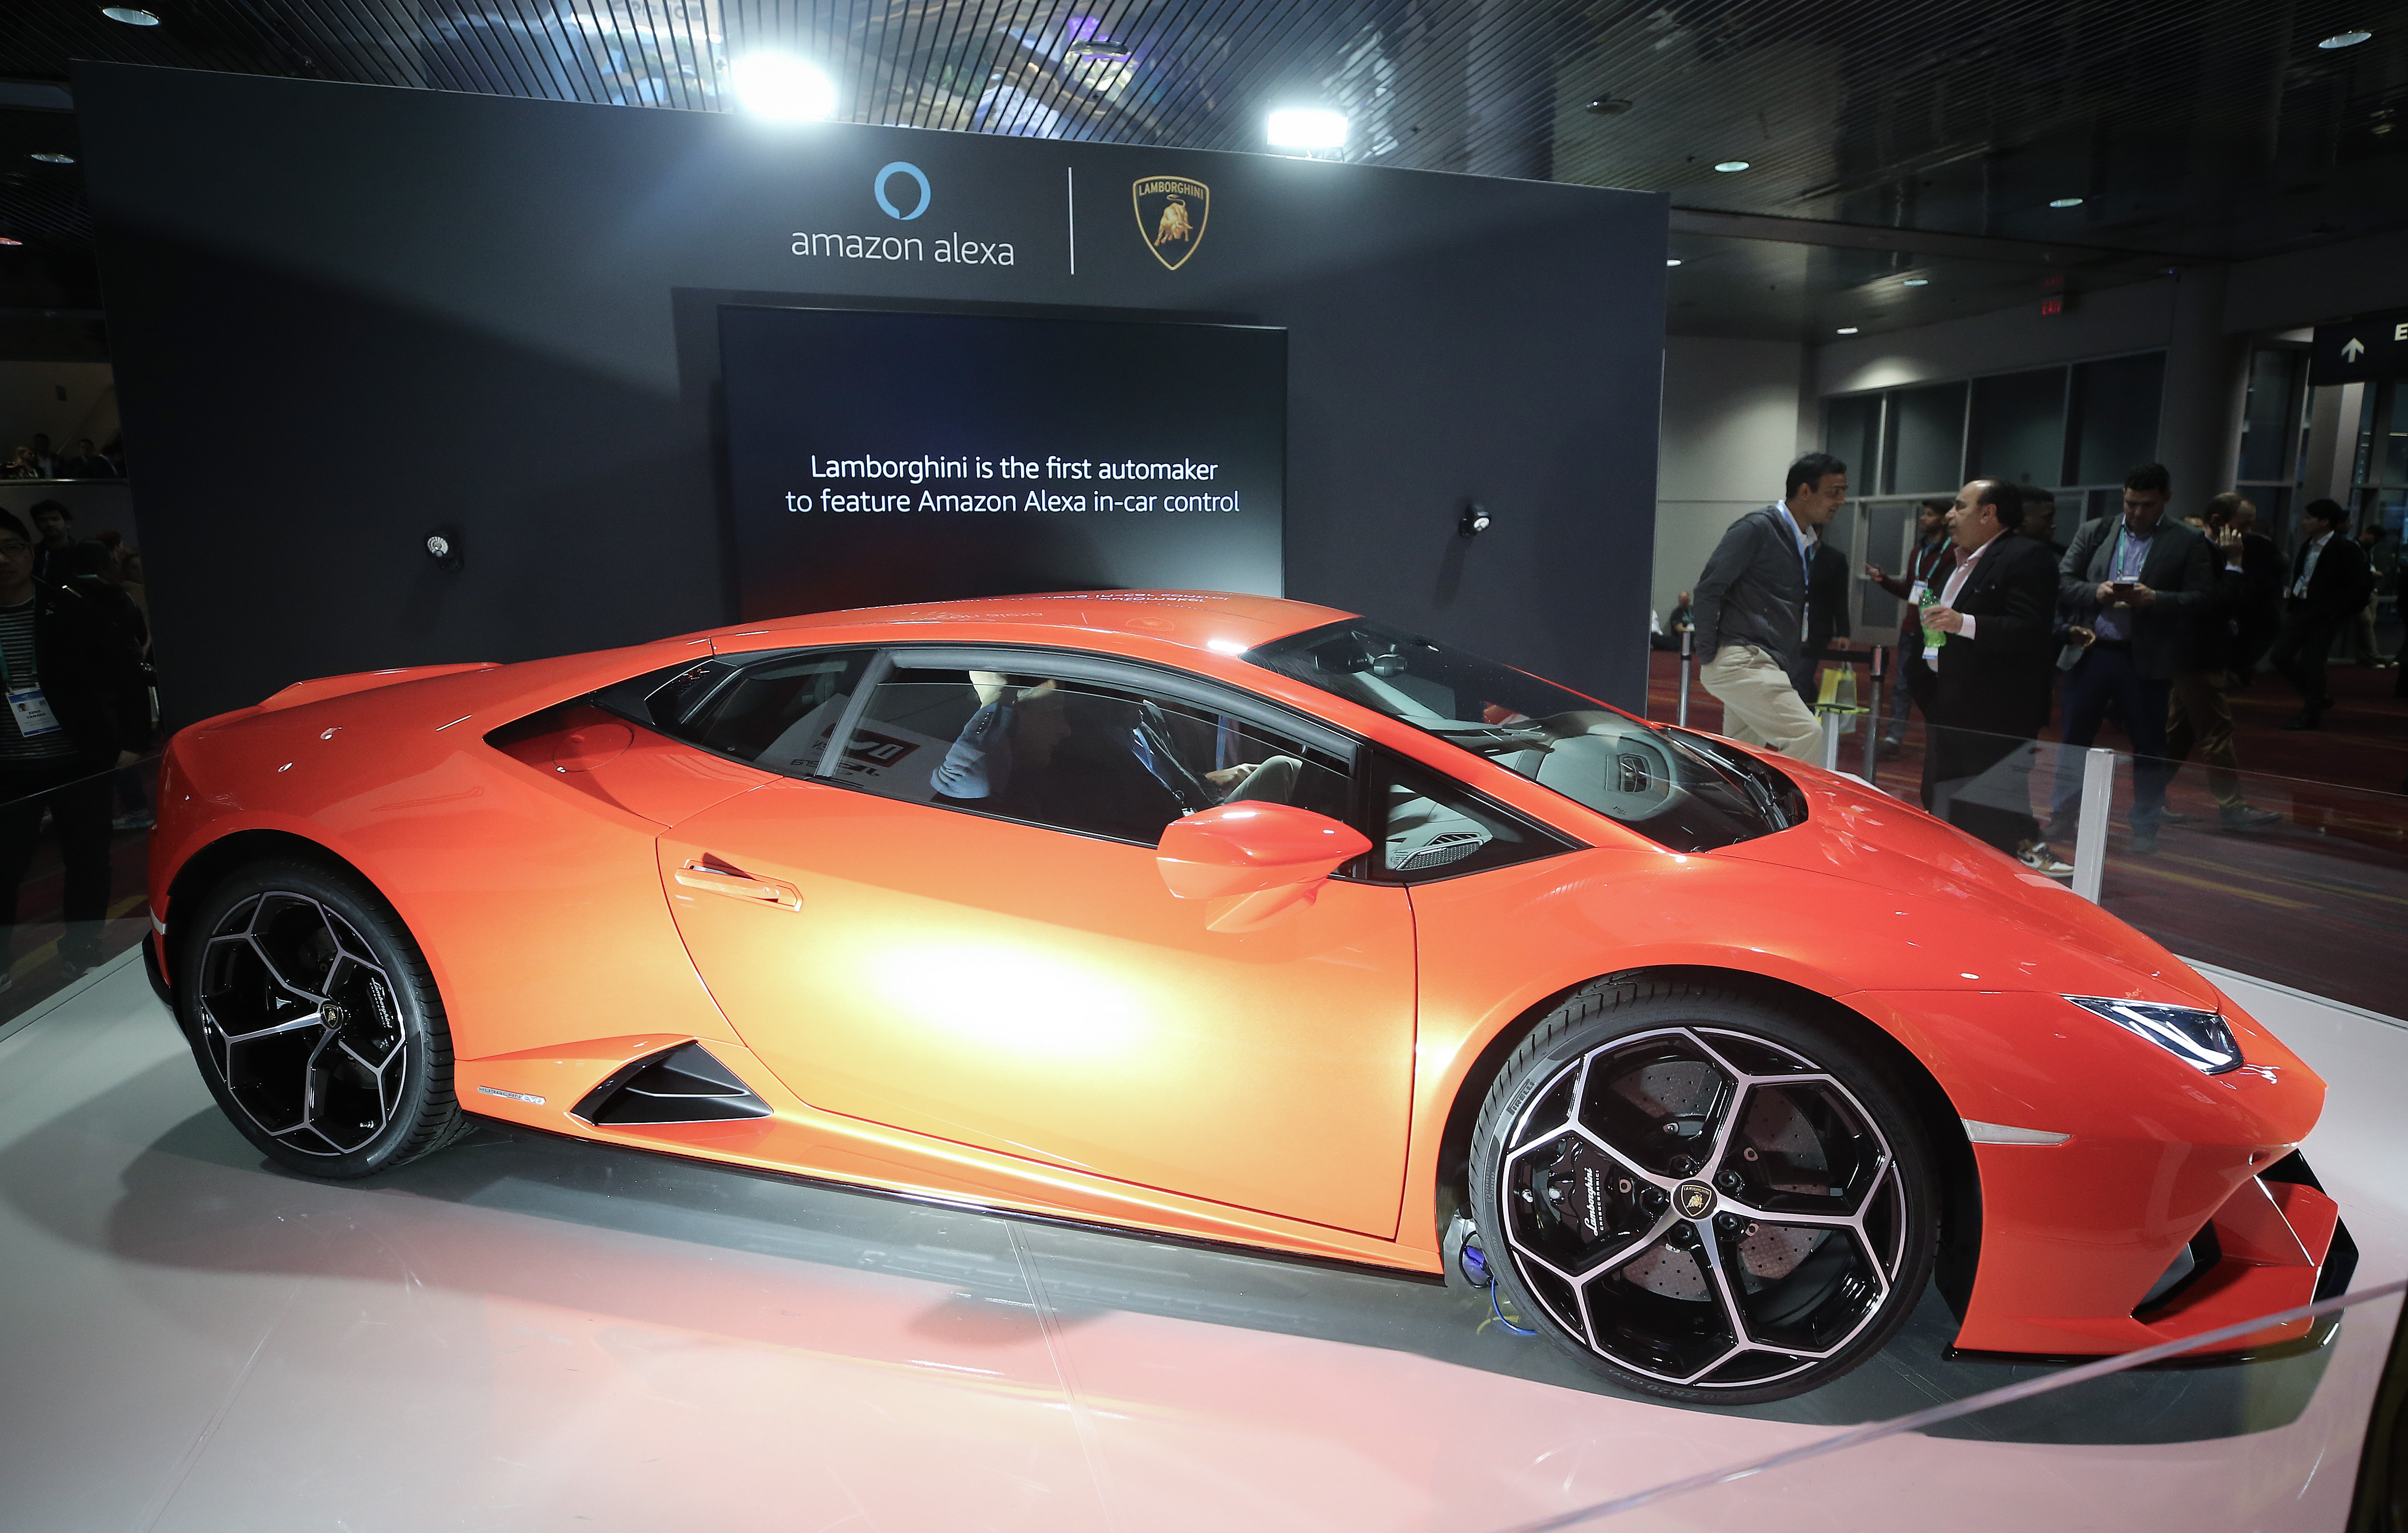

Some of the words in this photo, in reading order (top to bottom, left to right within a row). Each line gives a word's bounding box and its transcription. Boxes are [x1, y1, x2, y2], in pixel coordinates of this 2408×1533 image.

[1139, 181, 1204, 197] LAMBORGHINI
[791, 231, 923, 261] amazon
[934, 231, 1014, 266] alexa
[2394, 322, 2408, 341] E
[811, 454, 968, 484] Lamborghini
[975, 455, 994, 479] is
[999, 455, 1039, 479] the
[1045, 455, 1093, 479] first
[1099, 457, 1219, 480] automaker
[784, 491, 813, 512] to
[820, 488, 911, 512] feature
[917, 490, 1017, 512] Amazon
[1023, 489, 1086, 512] Alexa
[1093, 490, 1158, 512] in-car
[1163, 490, 1240, 512] control
[371, 977, 393, 1028] Lamborghini
[521, 1095, 546, 1105] EVO
[1506, 1079, 1535, 1116] PIRELLI
[1584, 1167, 1598, 1237] Lamborghini
